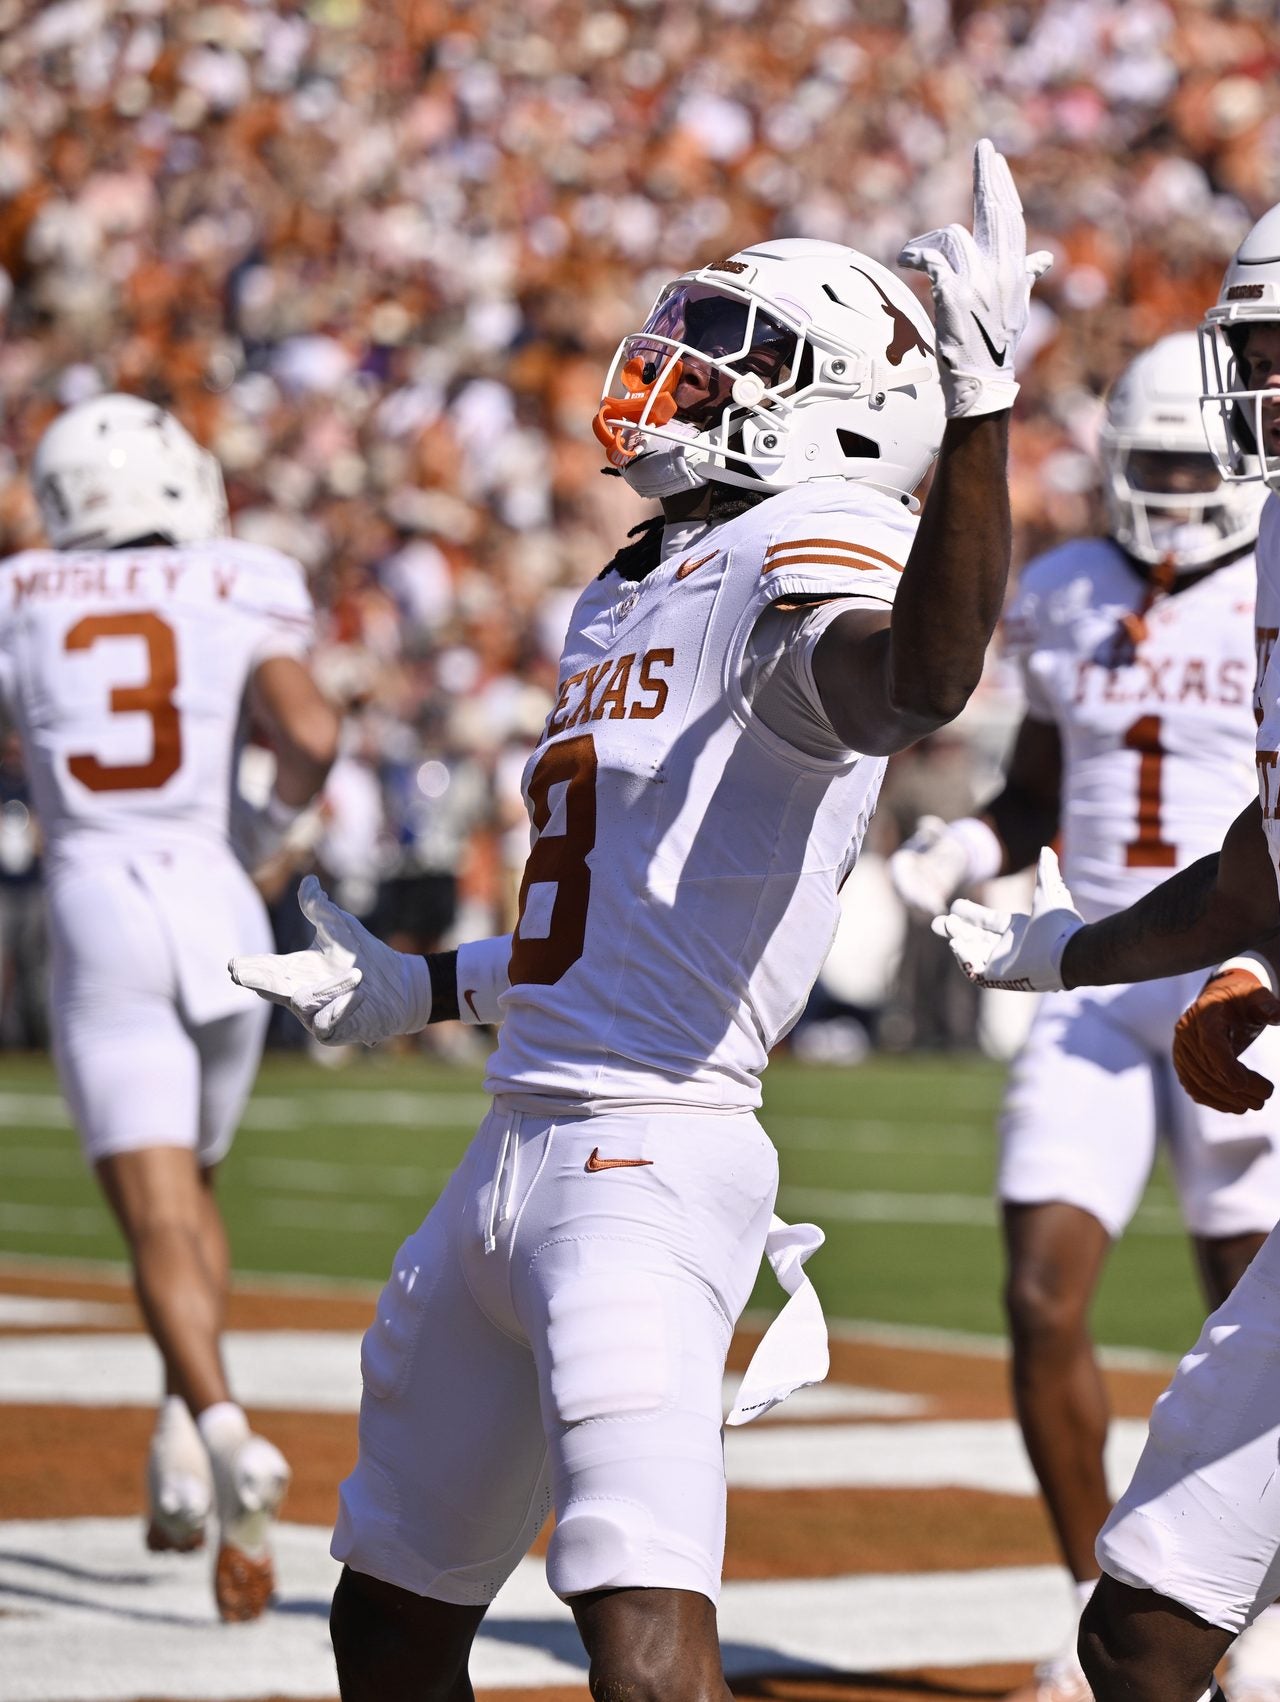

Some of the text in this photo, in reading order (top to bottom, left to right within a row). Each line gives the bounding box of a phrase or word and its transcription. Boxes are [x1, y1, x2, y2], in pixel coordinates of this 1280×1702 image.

[10, 560, 240, 607] MOSLEY V
[64, 610, 183, 792] 3
[540, 648, 675, 742] EXAS
[1073, 657, 1247, 706] TEXAS
[1123, 714, 1177, 867] 1
[507, 732, 598, 985] 8
